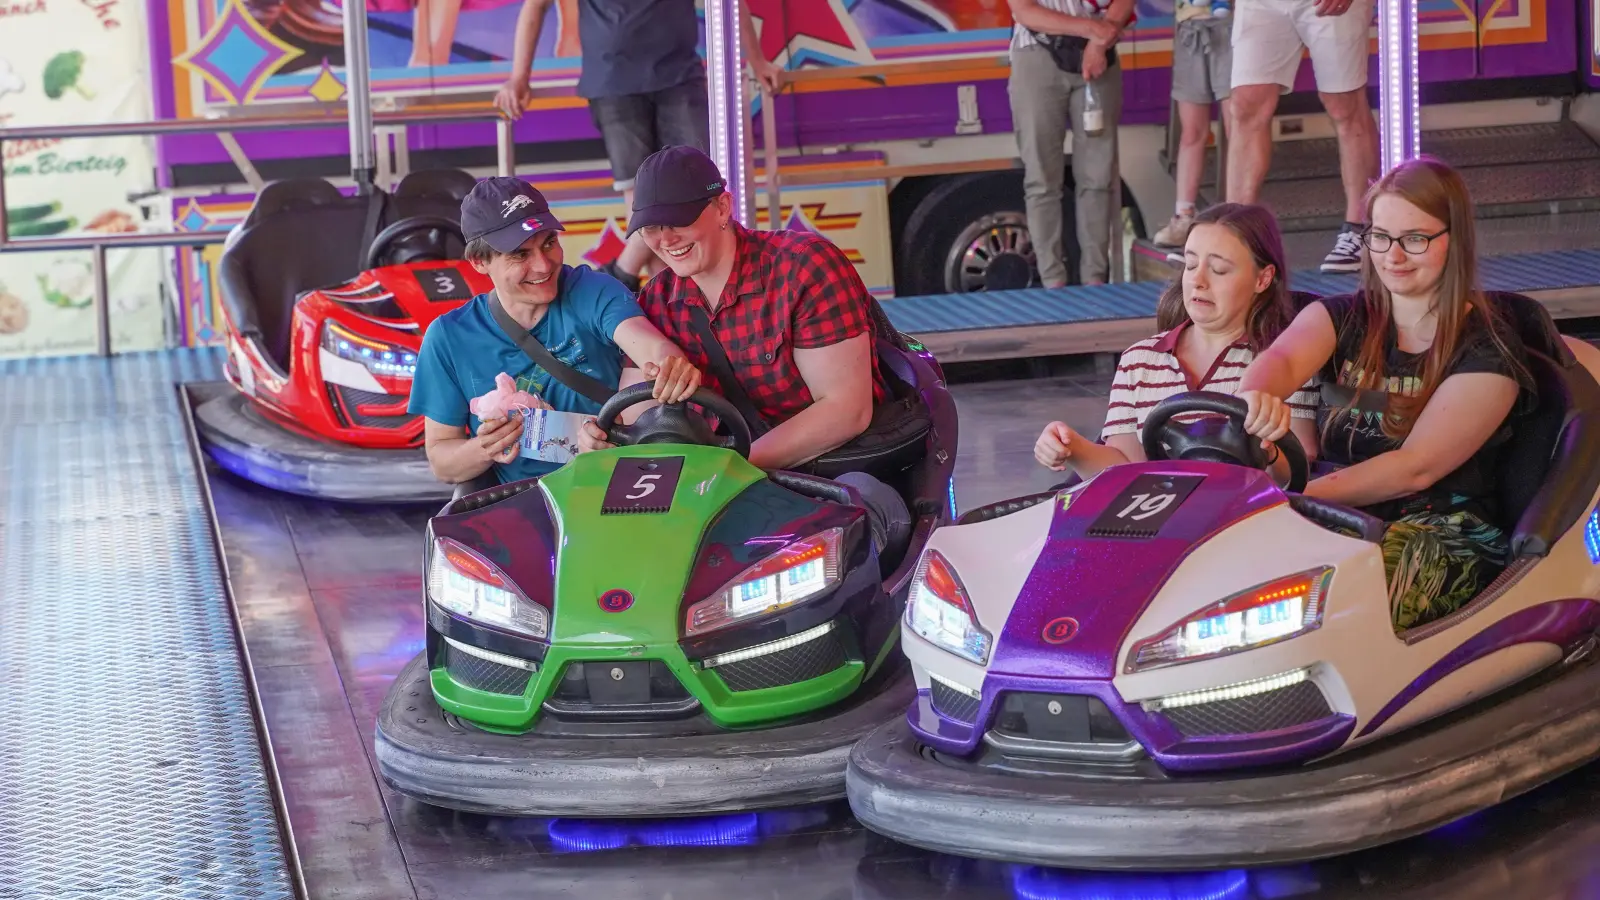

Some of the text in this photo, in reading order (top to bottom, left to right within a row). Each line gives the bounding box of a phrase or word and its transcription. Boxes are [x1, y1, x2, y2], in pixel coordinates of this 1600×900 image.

[435, 276, 455, 293] 3
[625, 474, 663, 500] 5
[1116, 493, 1177, 521] 19
